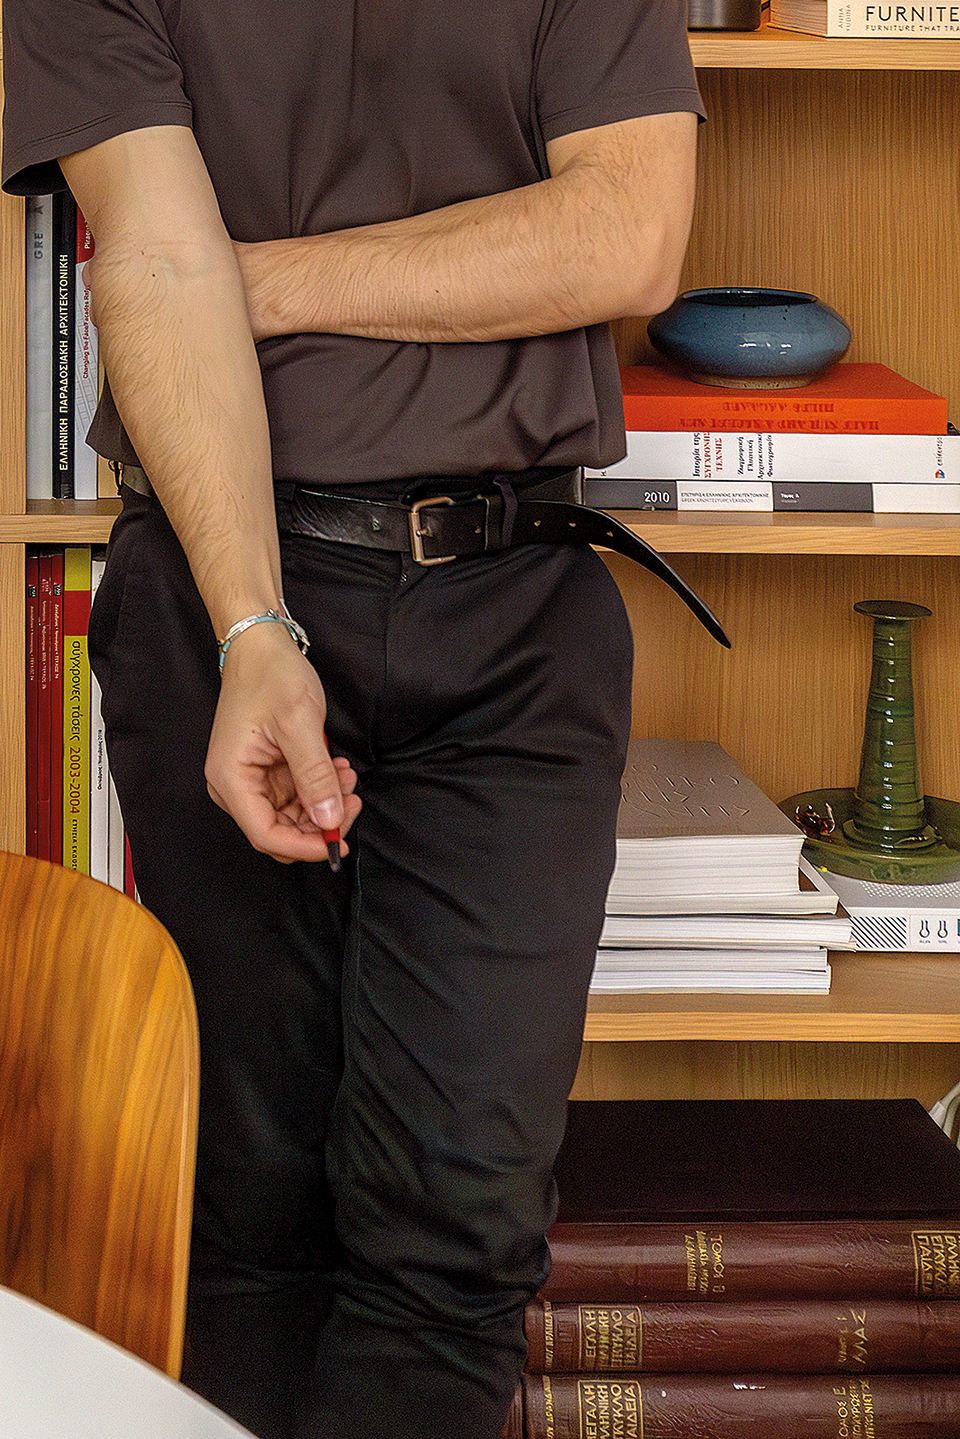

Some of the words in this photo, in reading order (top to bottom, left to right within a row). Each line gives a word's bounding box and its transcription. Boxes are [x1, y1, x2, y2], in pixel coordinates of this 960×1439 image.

[865, 6, 960, 21] FURNITE
[59, 255, 69, 336] ΑΡΧΙΤΕΚΤΟΝΙΚΗ
[59, 340, 69, 413] ΠΑΡΑΔΟΣΙΑΚΗ
[59, 418, 69, 471] ΕΛΛΗΝΙΚΗ
[644, 491, 670, 503] 2010
[70, 640, 82, 701] σύγχρονες
[70, 705, 82, 742] τάσεις
[69, 746, 81, 814] 2003-2004
